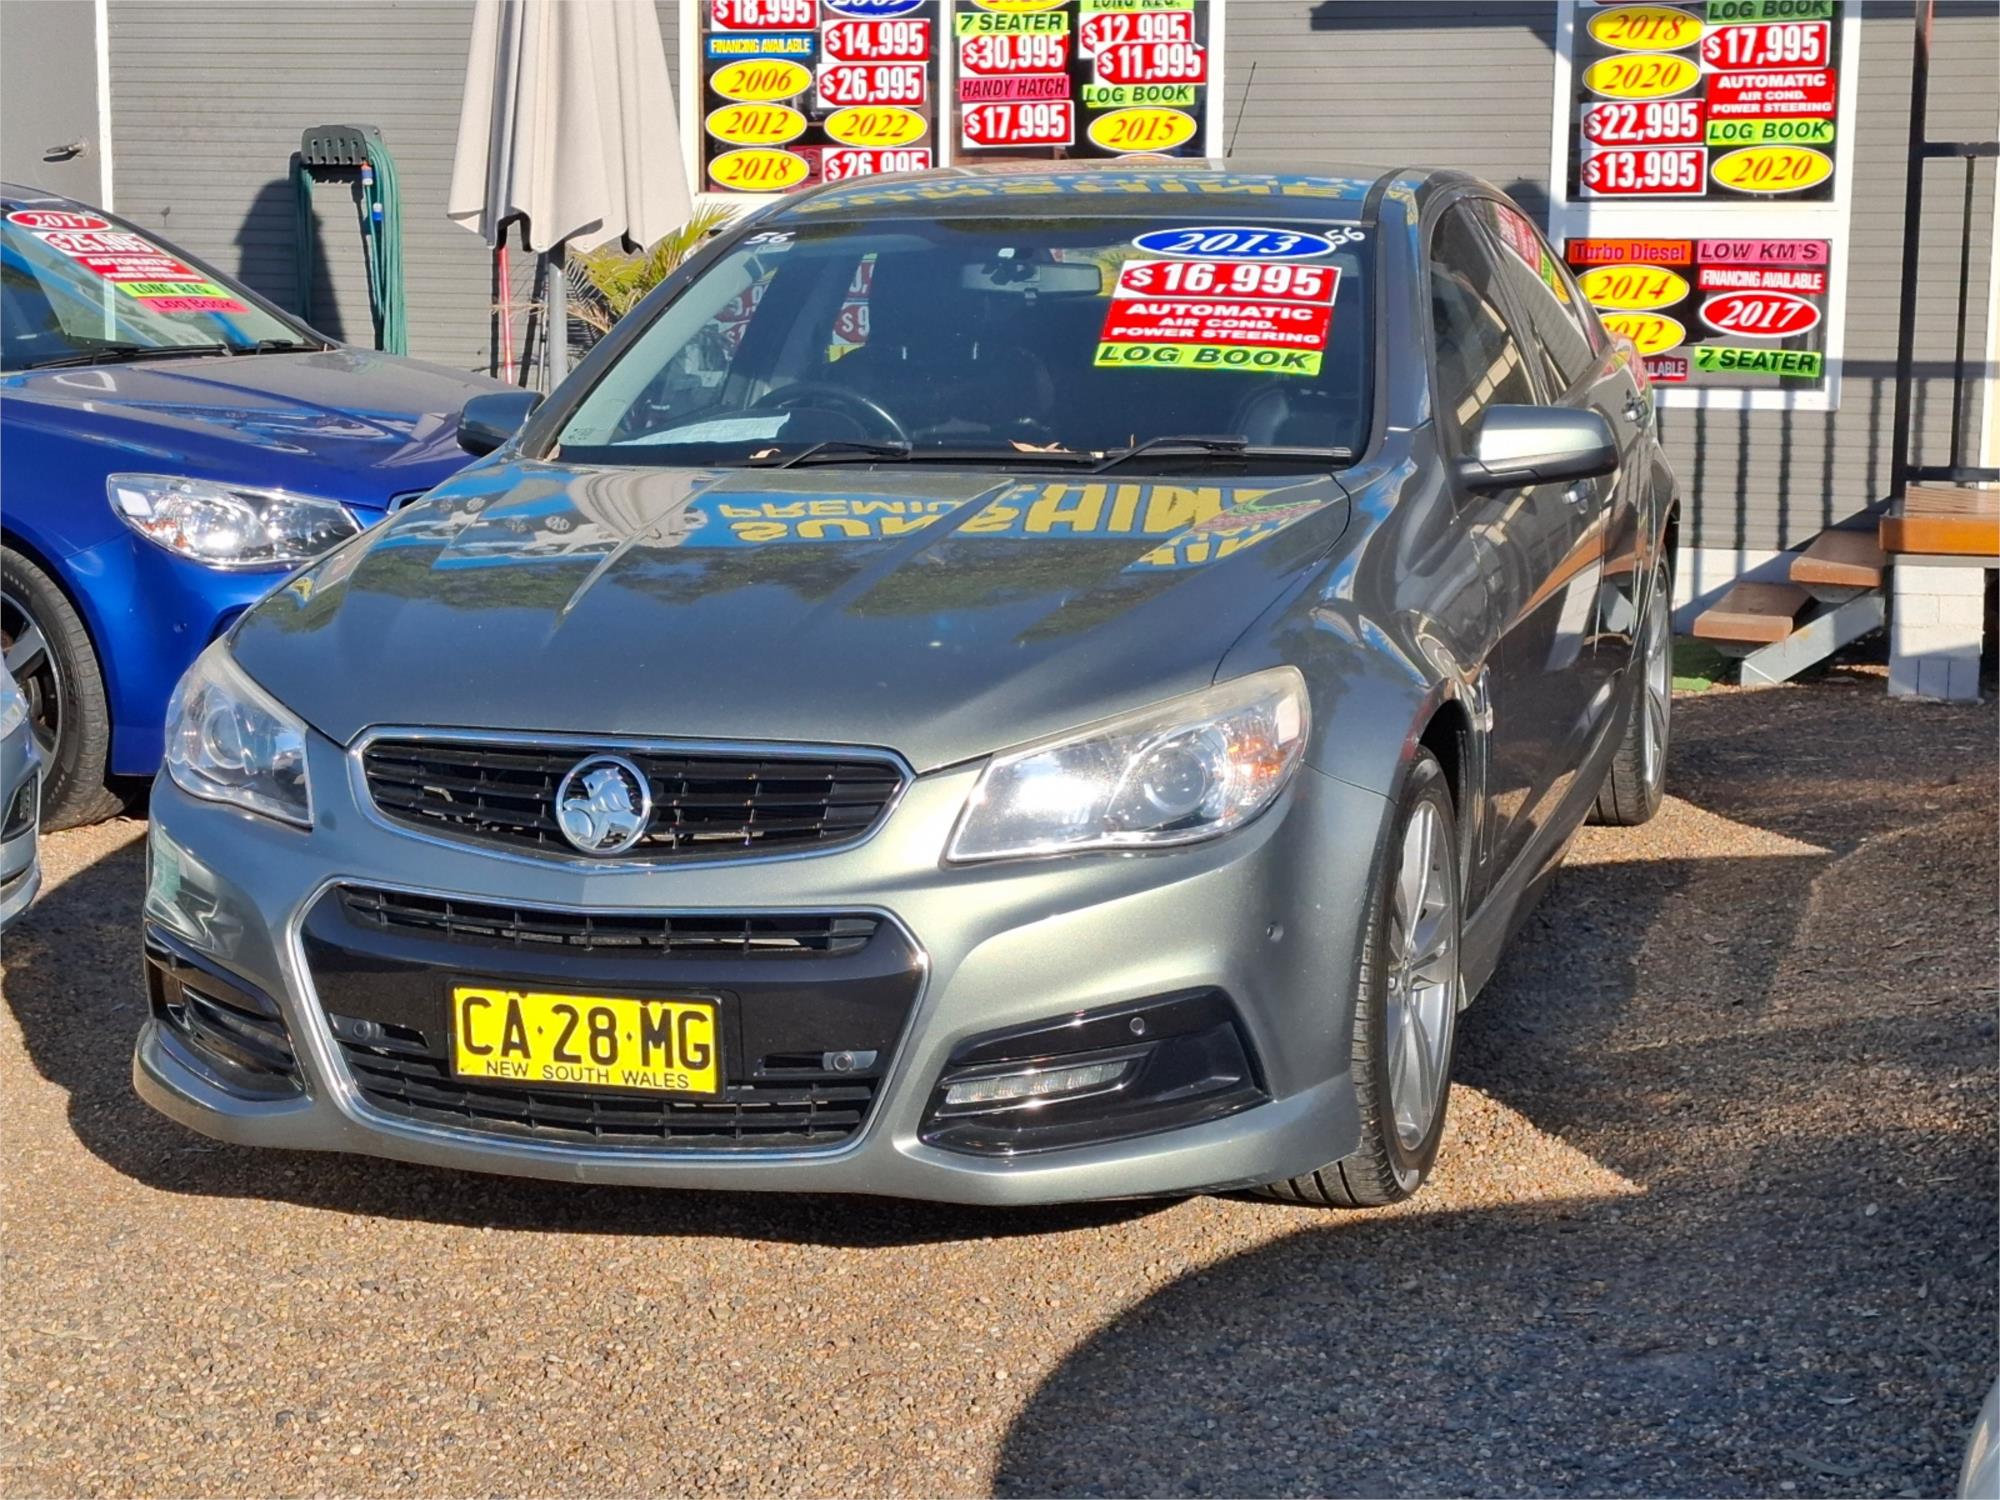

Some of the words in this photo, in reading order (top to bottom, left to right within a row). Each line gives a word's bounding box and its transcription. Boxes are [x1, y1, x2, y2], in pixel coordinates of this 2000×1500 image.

[714, 0, 812, 24] $18,995
[1709, 2, 1754, 20] LOG
[1762, 0, 1828, 17] BOOK
[960, 15, 973, 32] 7
[979, 14, 1063, 31] SEATER
[1084, 14, 1187, 43] $12995
[1607, 15, 1687, 41] 2018
[711, 39, 759, 54] FINANCING
[761, 38, 811, 53] AVAILABLE
[827, 22, 925, 57] $14,995
[1706, 25, 1820, 65] $17,995
[964, 35, 1065, 70] $30,995
[728, 69, 792, 94] 2006
[822, 67, 921, 102] $26,995
[962, 79, 1012, 97] HANDY
[1016, 77, 1066, 96] HATCH
[1603, 62, 1682, 90] 2020
[1717, 74, 1827, 89] AUTOMATIC
[1085, 88, 1124, 103] LOG
[1132, 85, 1190, 102] BOOK
[1738, 91, 1760, 101] AIR
[1764, 90, 1807, 101] COND.
[1712, 104, 1760, 114] POWER
[1763, 102, 1832, 113] STEERING
[724, 111, 789, 135] 2012
[842, 113, 909, 137] 2022
[966, 105, 1065, 140] $17,995
[1109, 116, 1178, 144] 2015
[1587, 103, 1698, 141] $22,995
[1709, 123, 1753, 140] LOG
[1762, 121, 1828, 138] BOOK
[726, 157, 792, 181] 2018
[1585, 151, 1698, 188] $13,995
[1732, 156, 1813, 183] 2020
[26, 214, 90, 228] 2017
[744, 231, 796, 245] 56
[1163, 232, 1303, 254] 2013
[1324, 227, 1366, 246] 56
[87, 257, 178, 267] AUTOMATIC
[1574, 243, 1625, 261] Turbo
[1631, 243, 1686, 261] Diesel
[1701, 243, 1750, 260] LOW
[1759, 243, 1818, 260] KM'S
[130, 284, 172, 295] LONG
[1129, 262, 1324, 297] $16,995
[1592, 274, 1672, 300] 2014
[1702, 269, 1760, 287] FINANCING
[1762, 272, 1823, 290] AVAILABLE
[1126, 303, 1314, 321] AUTOMATIC
[1158, 317, 1199, 328] AIR
[1205, 318, 1278, 330] COND.
[1719, 301, 1806, 328] 2017
[1111, 326, 1196, 338] POWER
[1201, 328, 1321, 344] STEERING
[1098, 345, 1181, 363] LOG
[1192, 348, 1314, 369] BOOK
[1699, 348, 1714, 367] 7
[1719, 350, 1818, 372] SEATER
[486, 1060, 530, 1078] NEW
[542, 1065, 611, 1085] SOUTH
[621, 1071, 690, 1090] WALES
